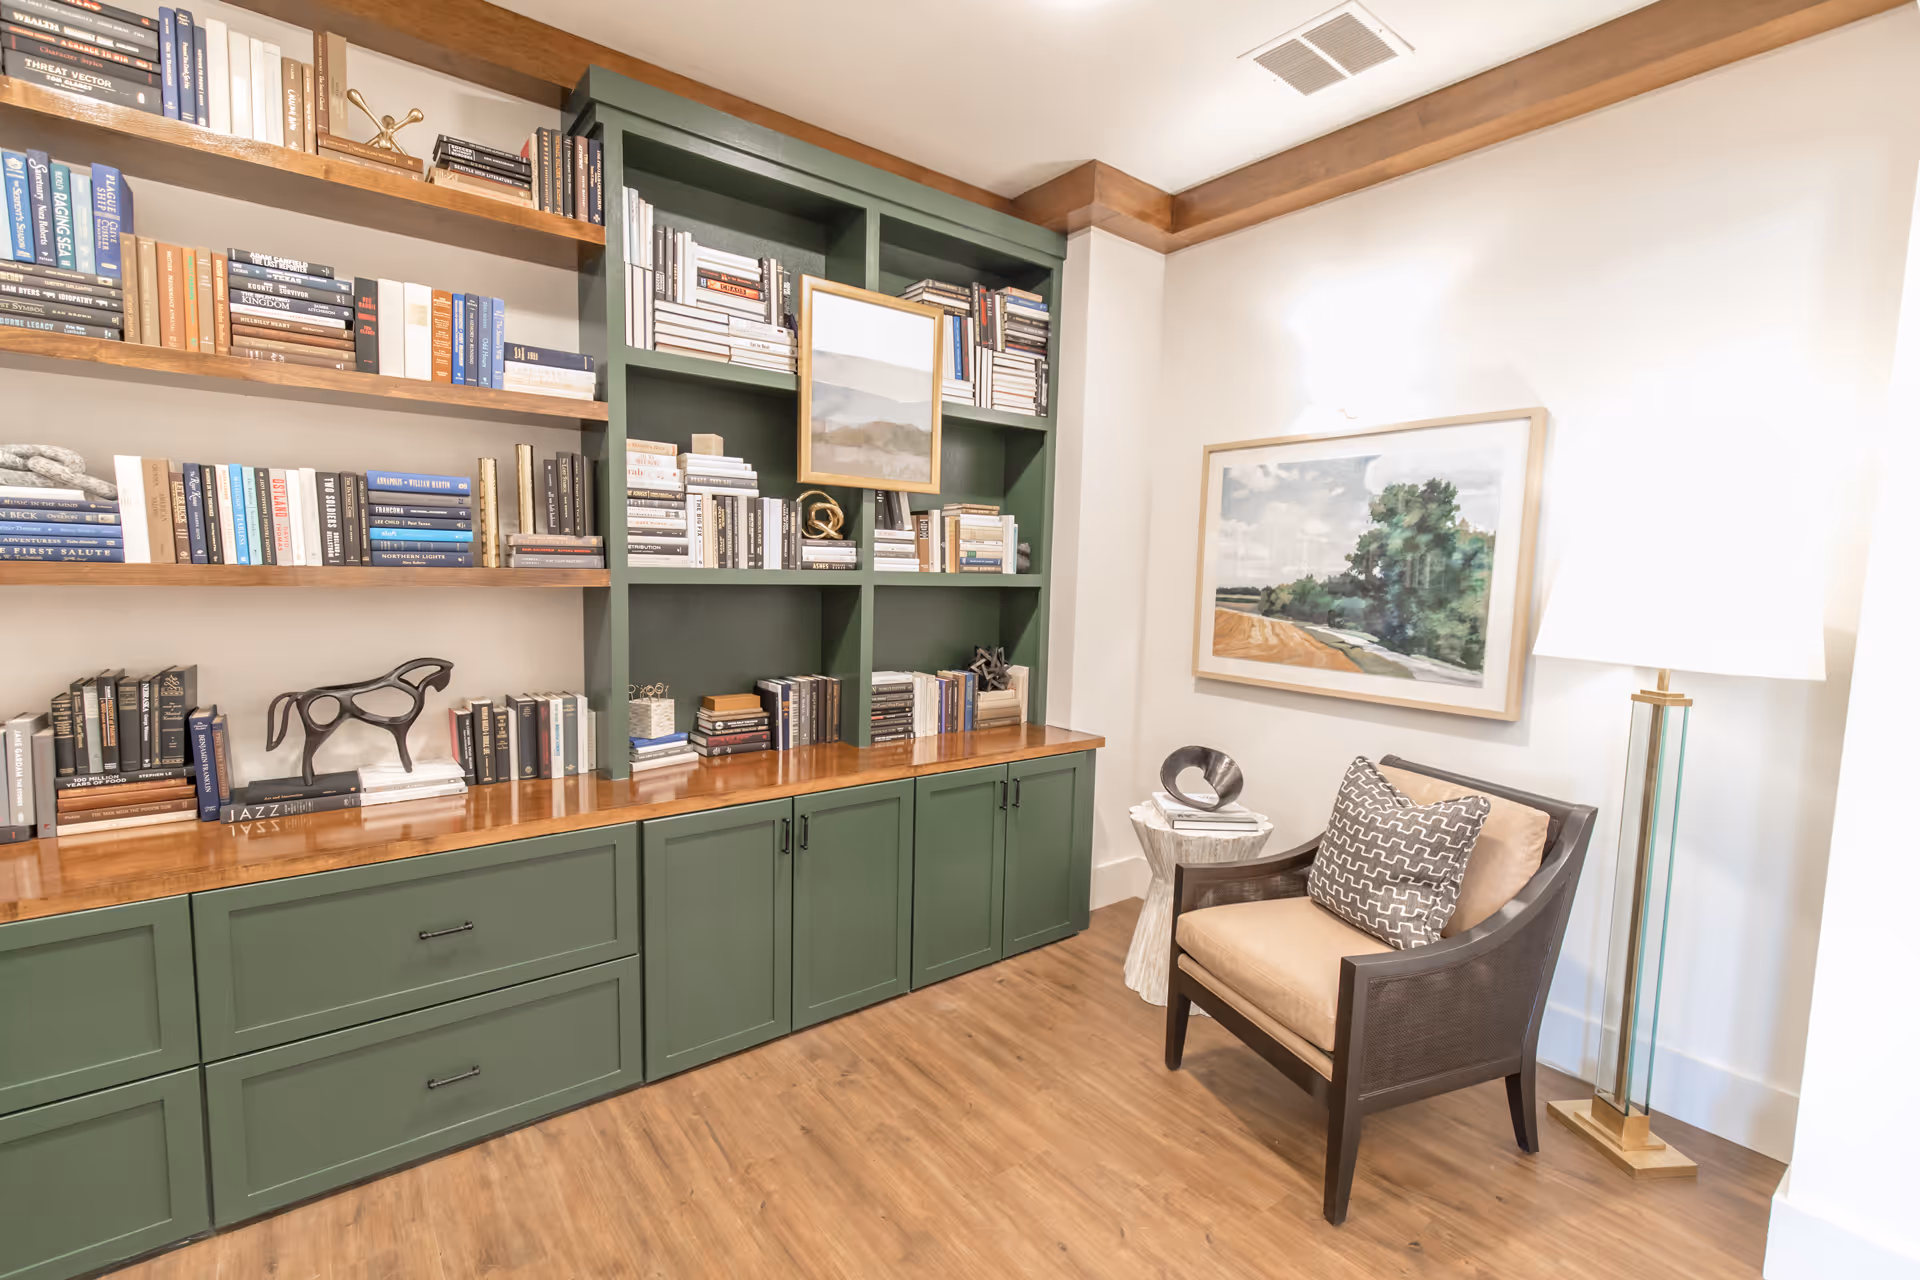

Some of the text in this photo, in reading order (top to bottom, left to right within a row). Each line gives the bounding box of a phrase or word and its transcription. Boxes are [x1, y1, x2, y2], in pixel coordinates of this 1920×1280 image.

[13, 12, 59, 32] WEALTH
[39, 46, 77, 62] Character
[25, 58, 112, 88] THREAT VECTOR
[454, 164, 512, 184] SEATTLE LITERATURE
[29, 158, 48, 245] Sanctuary Nora Roberts
[96, 187, 106, 211] SHIP
[106, 174, 116, 213] PLAGUE
[54, 192, 70, 235] RAGING
[16, 223, 26, 249] SHADOW
[101, 219, 110, 250] CUSSLER
[110, 221, 118, 243] CLIVE
[58, 236, 71, 256] SEA
[250, 252, 308, 268] ADAM CANFIELD
[279, 263, 308, 273] REPORTER
[248, 283, 273, 292] KOONTZ
[273, 274, 302, 284] TEXAS
[1, 284, 92, 304] SAM BYERS IDIOPATHY
[242, 296, 290, 310] KINGDOM
[279, 288, 309, 298] SURVIVOR
[12, 303, 45, 313] SYMBOL
[0, 318, 54, 330] OURNE LEGACY
[240, 317, 290, 329] HILLBILLY HEART
[377, 477, 402, 486] ANNAPOLIS
[409, 479, 430, 488] WILLIAM
[272, 479, 288, 517] OSTLAND
[324, 478, 337, 528] TWO SOLDIERS
[61, 549, 111, 557] SALUTE
[14, 730, 23, 747] JANE
[15, 748, 24, 778] GARDAM
[198, 735, 211, 793] BENJAMIN FRANKLIN
[228, 804, 280, 823] JAZZ
